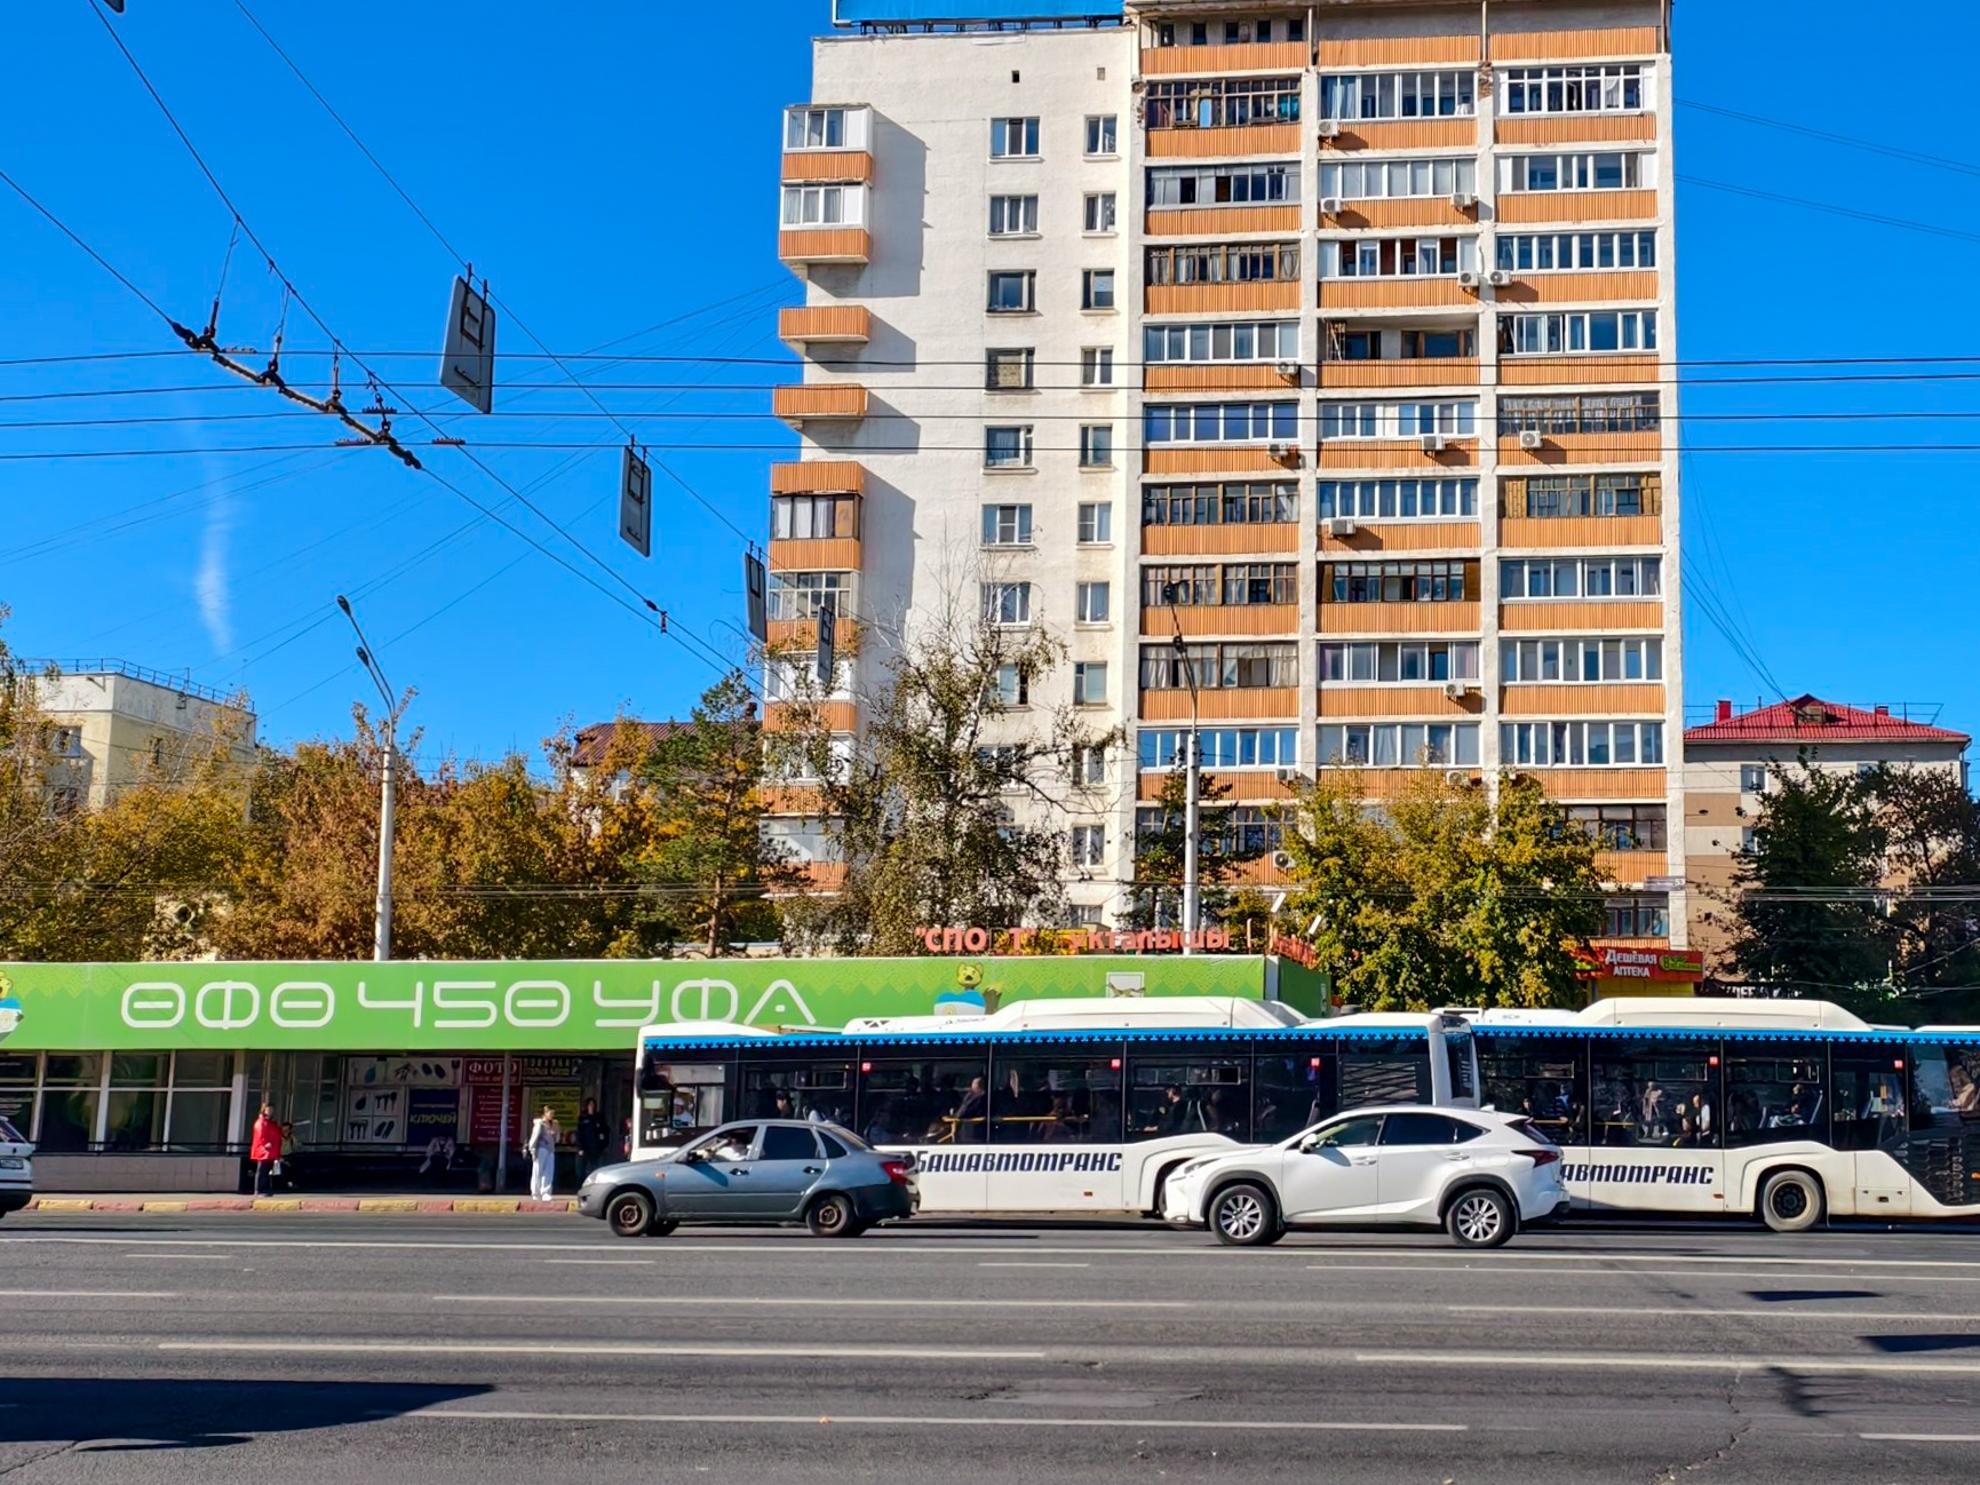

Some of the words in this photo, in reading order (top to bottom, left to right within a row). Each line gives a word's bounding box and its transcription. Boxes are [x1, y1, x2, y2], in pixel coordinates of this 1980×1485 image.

[1613, 965, 1650, 977] АПТЕКА
[593, 979, 817, 1027] УФА
[469, 1061, 518, 1074] ФОТО
